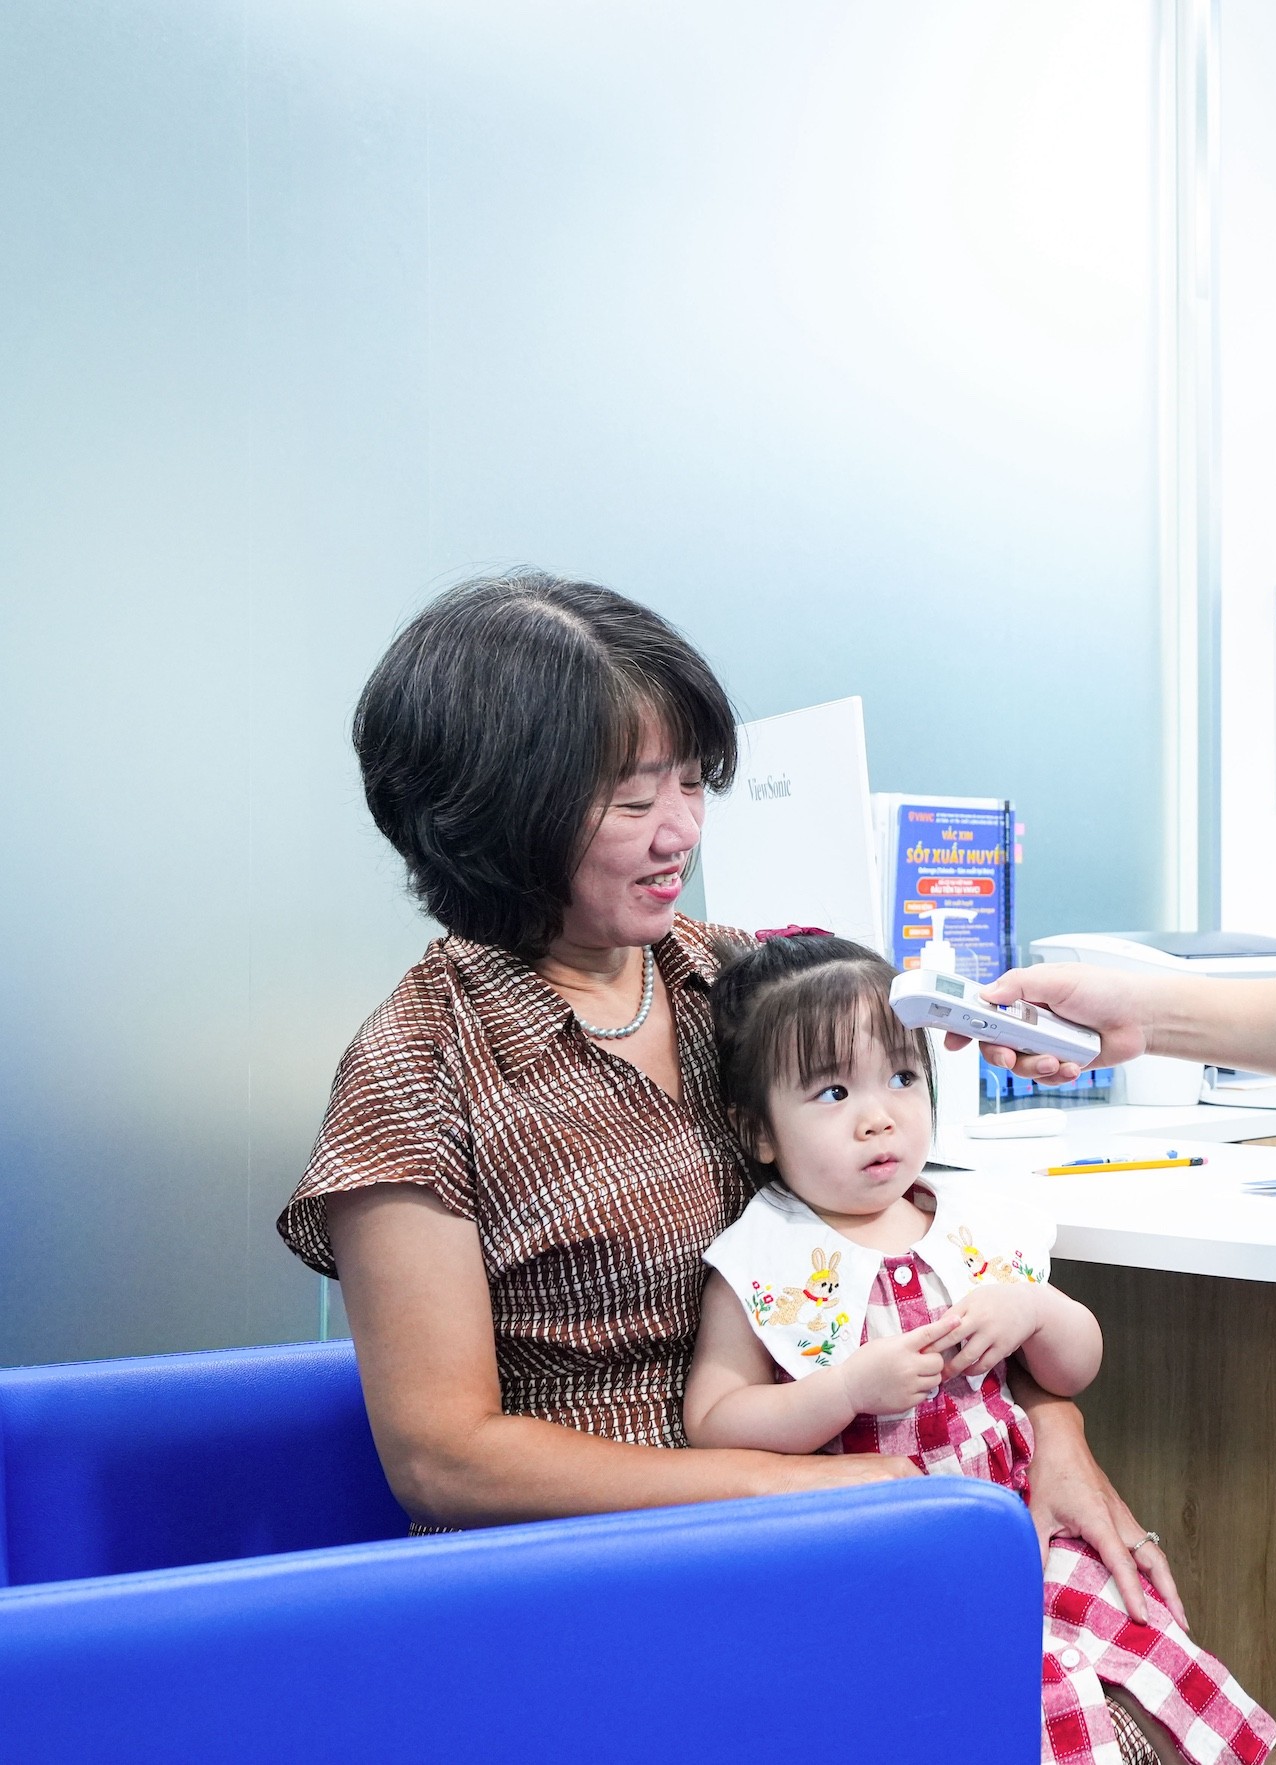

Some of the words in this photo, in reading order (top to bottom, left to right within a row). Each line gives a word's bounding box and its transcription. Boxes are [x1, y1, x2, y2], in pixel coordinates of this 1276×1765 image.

[748, 773, 791, 801] ViewSonic
[942, 825, 957, 841] VẮC
[906, 840, 930, 863] SỐT
[932, 842, 965, 864] XUẤT
